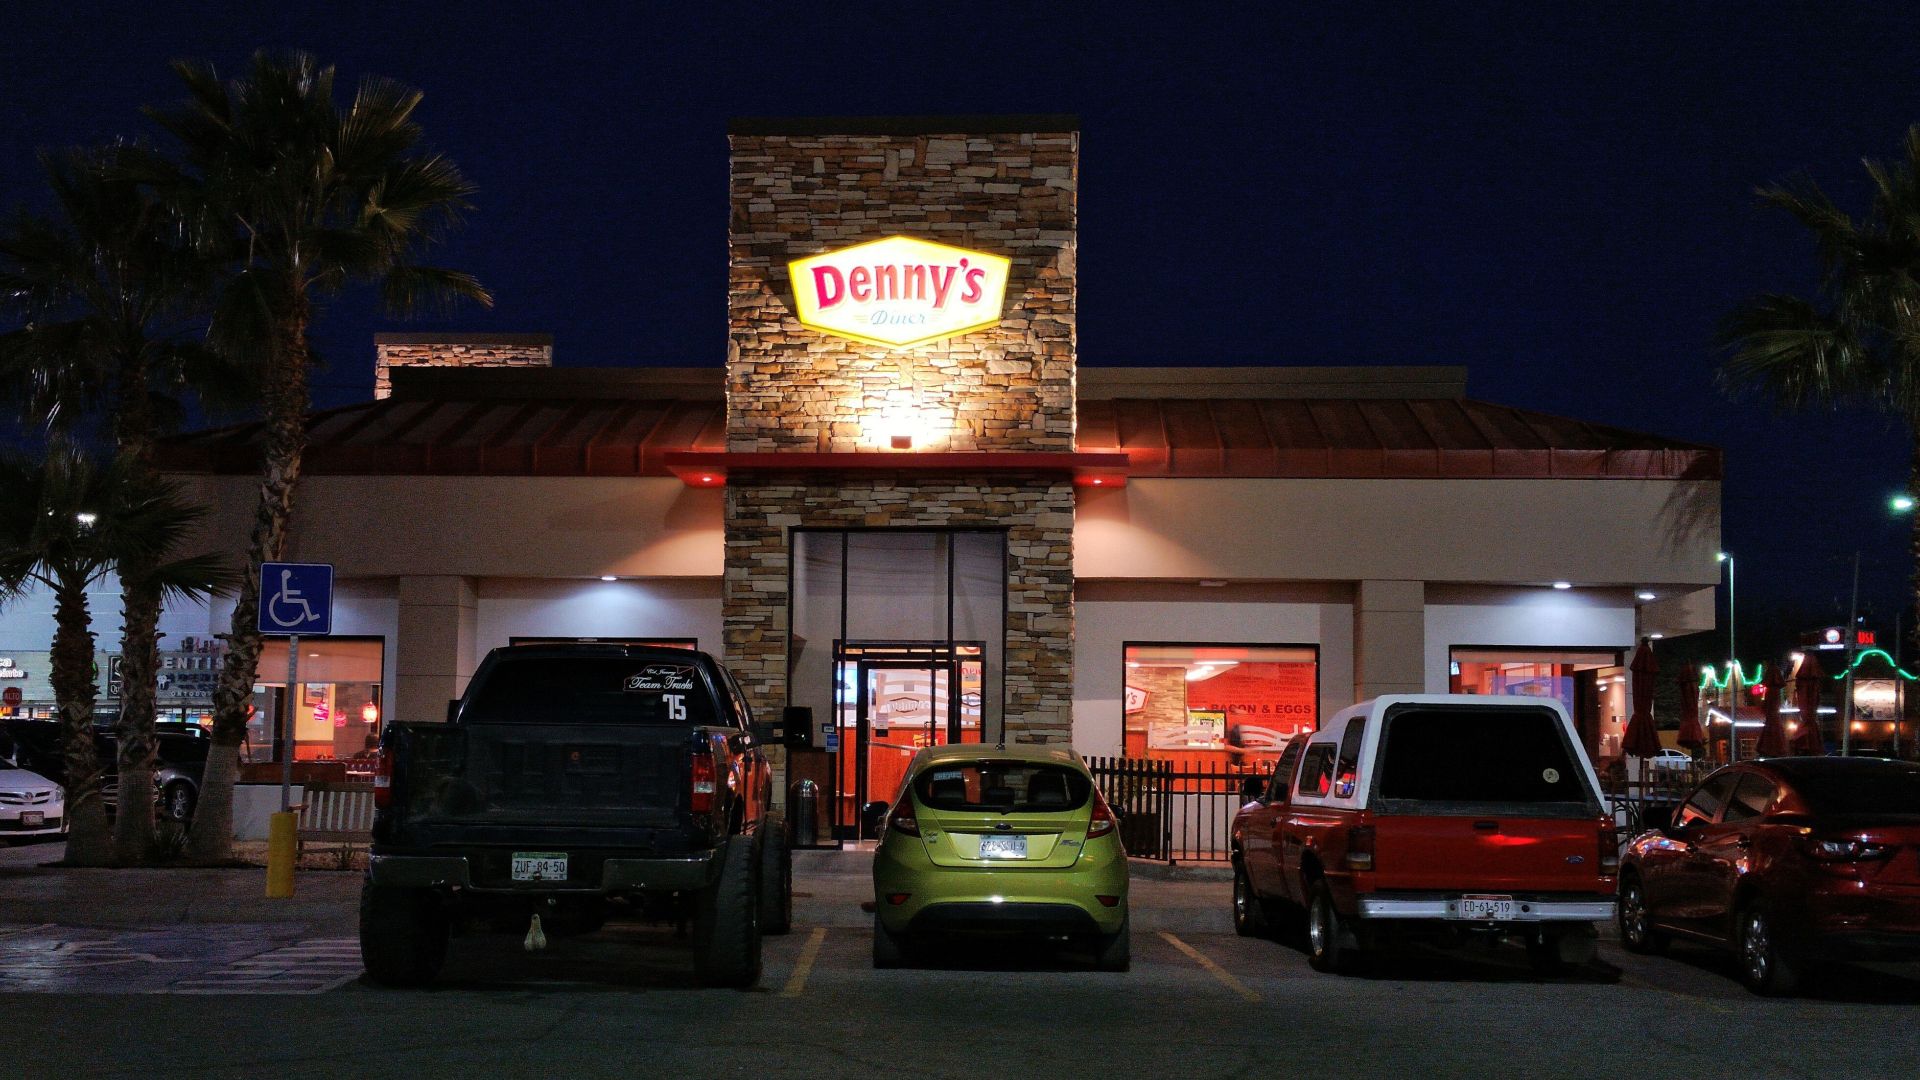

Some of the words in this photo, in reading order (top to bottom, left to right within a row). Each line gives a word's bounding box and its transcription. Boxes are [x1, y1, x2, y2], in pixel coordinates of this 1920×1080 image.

[810, 257, 986, 310] Denny's
[870, 309, 926, 325] Diner
[628, 676, 661, 689] Team
[662, 675, 694, 690] Trucks
[662, 694, 687, 720] 75
[1210, 703, 1256, 714] BACON
[1261, 704, 1271, 714] &
[1275, 704, 1312, 714] EGGS
[514, 860, 565, 873] ZUF-84-50
